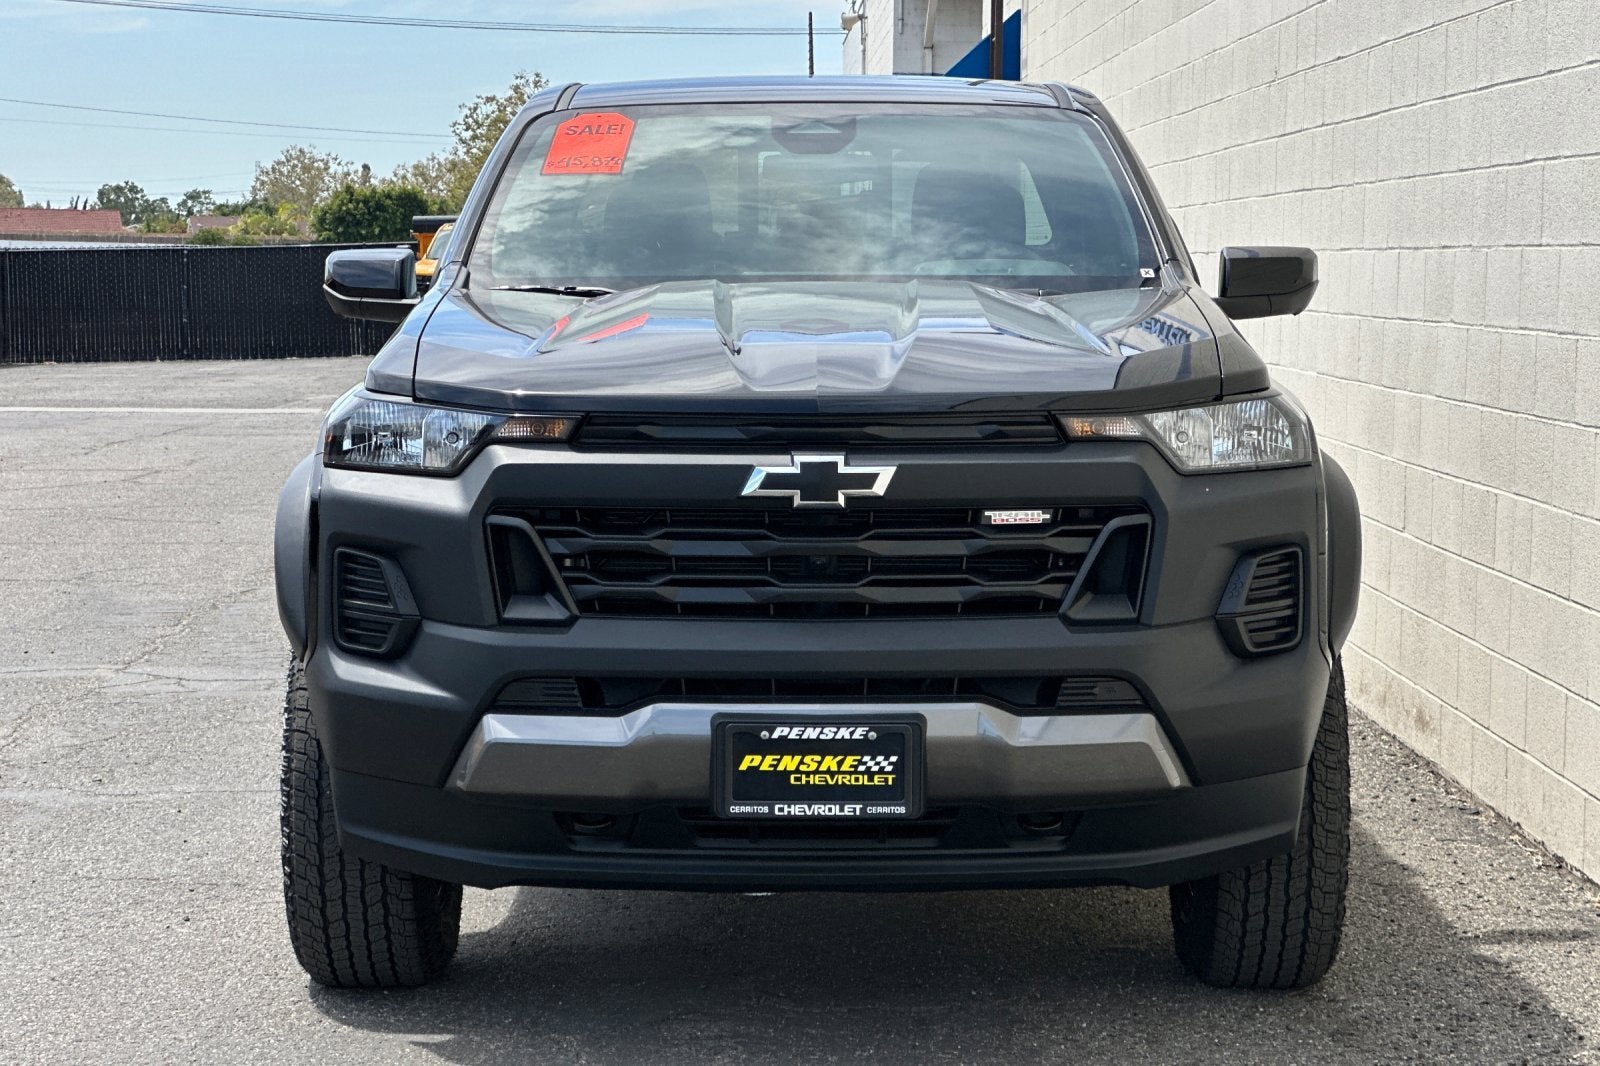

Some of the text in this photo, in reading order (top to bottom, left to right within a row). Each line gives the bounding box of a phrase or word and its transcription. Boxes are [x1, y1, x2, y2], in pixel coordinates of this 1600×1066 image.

[565, 124, 625, 136] SALE!
[771, 727, 869, 740] PENSKE
[738, 755, 860, 772] PENSKE
[790, 774, 896, 786] CHEVROLET
[730, 804, 906, 816] CERRITOS CHEVROLET CERRITOS
